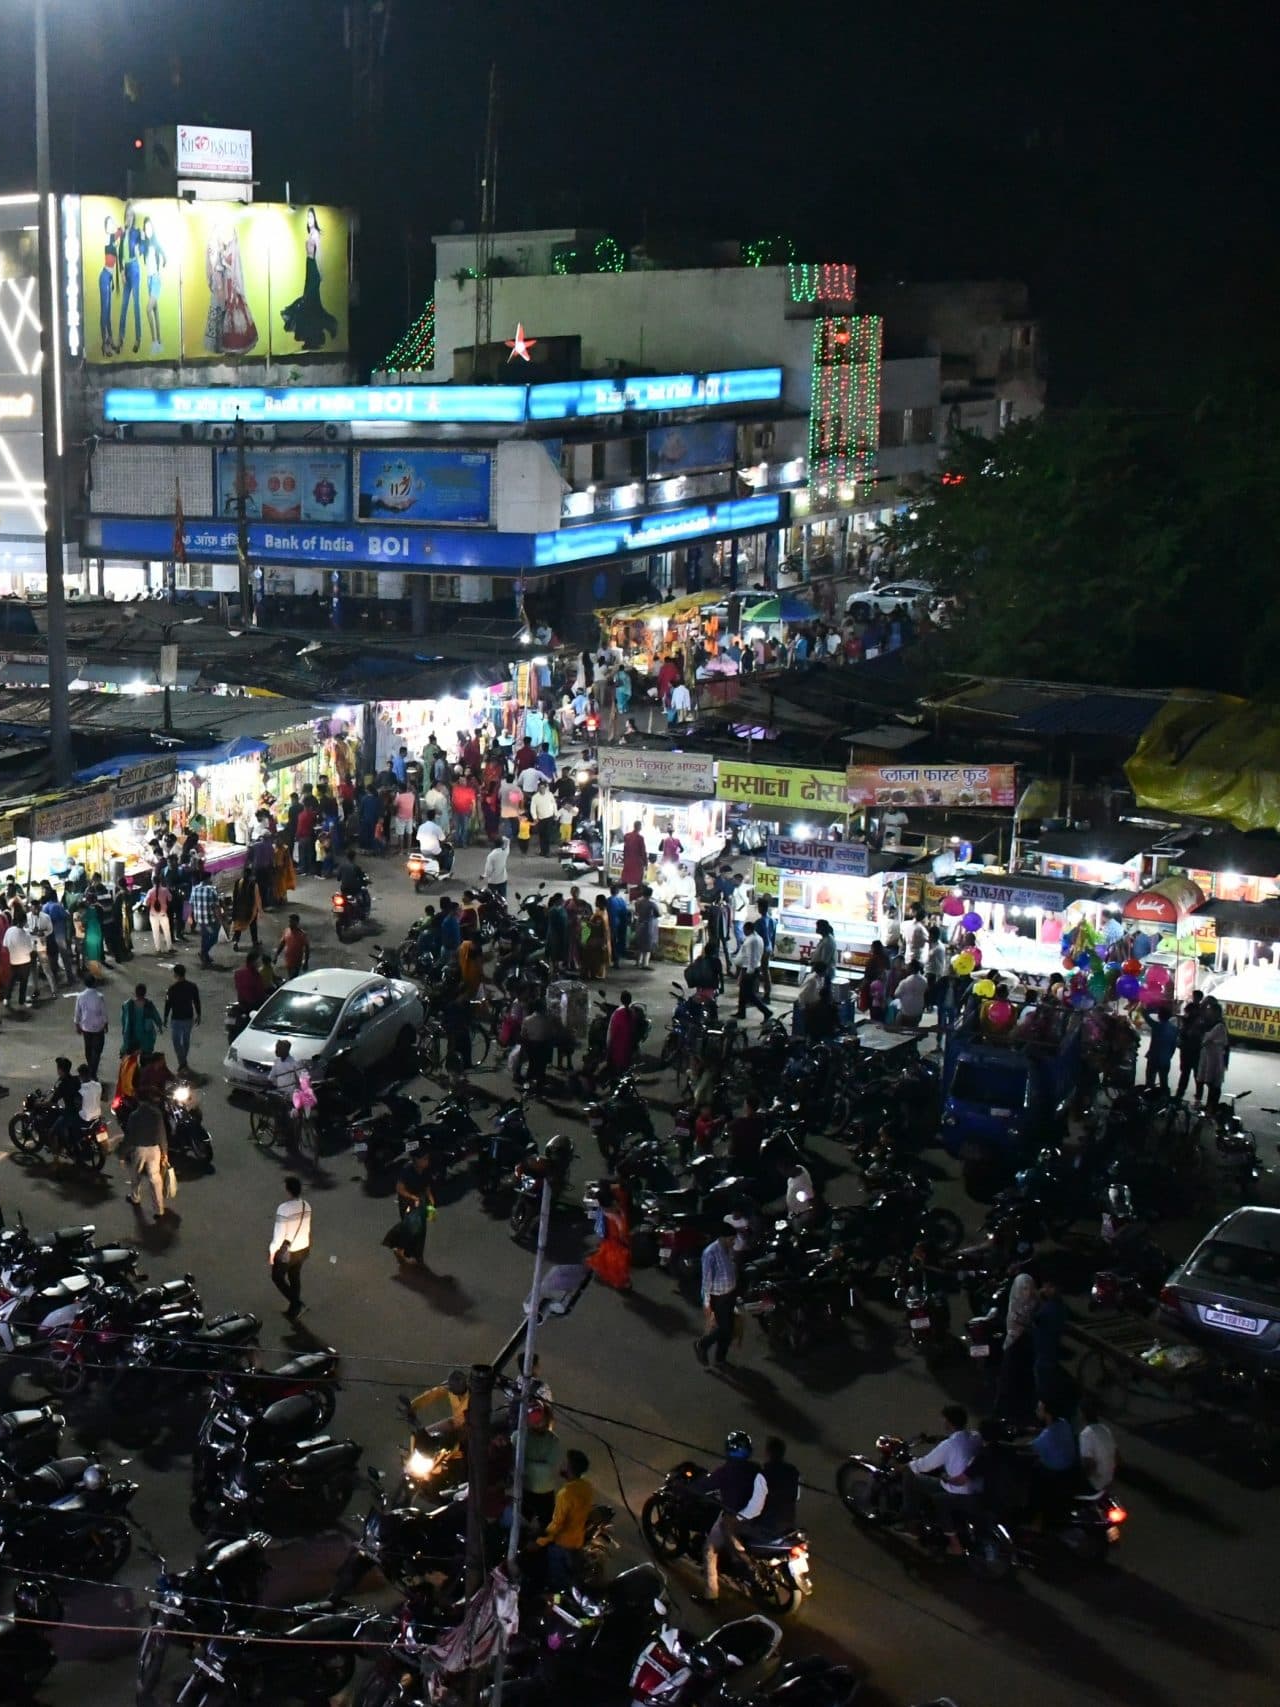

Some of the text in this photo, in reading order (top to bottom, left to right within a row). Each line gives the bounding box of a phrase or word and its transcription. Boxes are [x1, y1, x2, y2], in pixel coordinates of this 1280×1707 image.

[264, 391, 413, 414] Bank of India BOI
[264, 533, 410, 557] Bank of India BOI
[923, 768, 960, 782] फास्ट
[720, 773, 849, 803] मसाला ढोसा
[961, 883, 1014, 902] SANJAY
